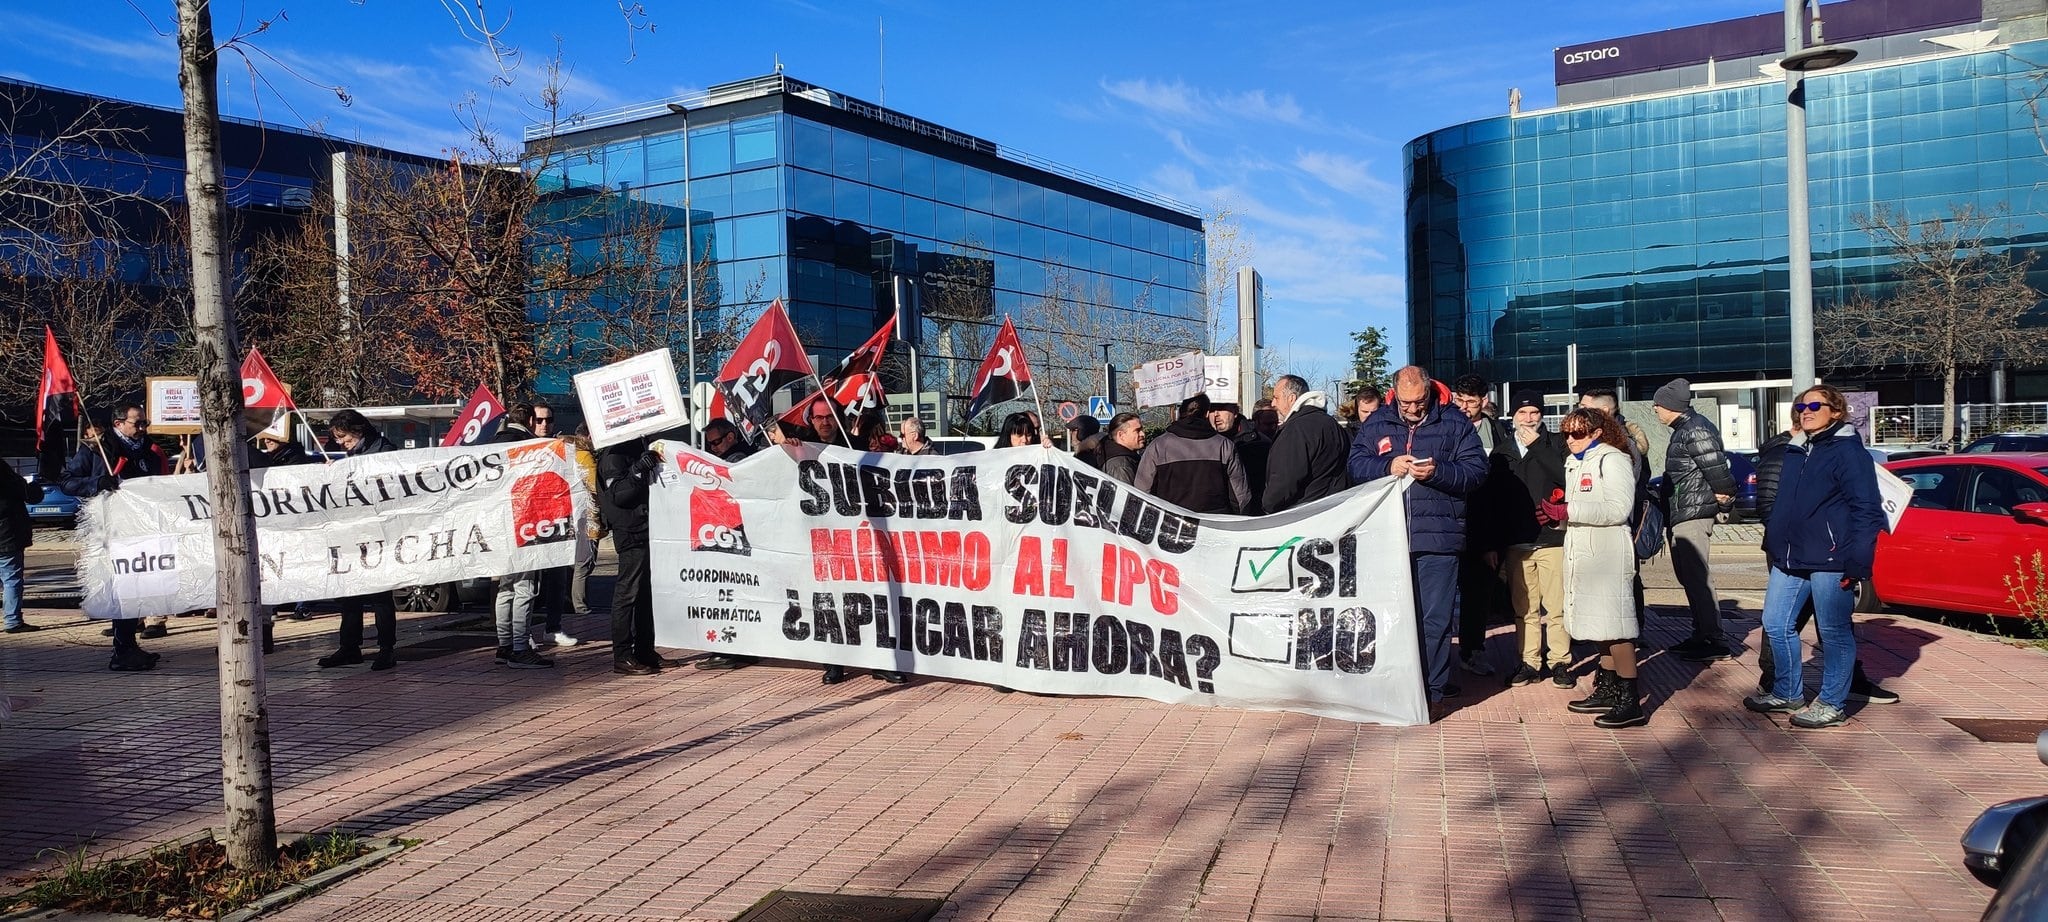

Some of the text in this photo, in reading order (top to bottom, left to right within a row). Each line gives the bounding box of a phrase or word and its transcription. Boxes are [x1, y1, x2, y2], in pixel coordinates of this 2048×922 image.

[1563, 46, 1620, 65] astara
[1156, 358, 1184, 373] FDS
[631, 381, 653, 392] indra
[1205, 377, 1229, 387] DS
[602, 390, 623, 401] indra
[180, 453, 504, 521] INORMÁTIC@S
[798, 459, 983, 521] SUBIDA
[519, 517, 569, 541] CGT
[698, 523, 744, 549] CGT
[111, 551, 176, 575] indra
[259, 524, 493, 582] N LUCHA
[679, 568, 760, 586] COORDINADORA
[810, 520, 1180, 615] MÍNIMO AL IPC
[718, 589, 734, 602] DE
[687, 605, 761, 623] INFORMÁTICA
[782, 589, 1221, 694] ¿APLICAR AHORA?
[1295, 606, 1377, 675] NO
